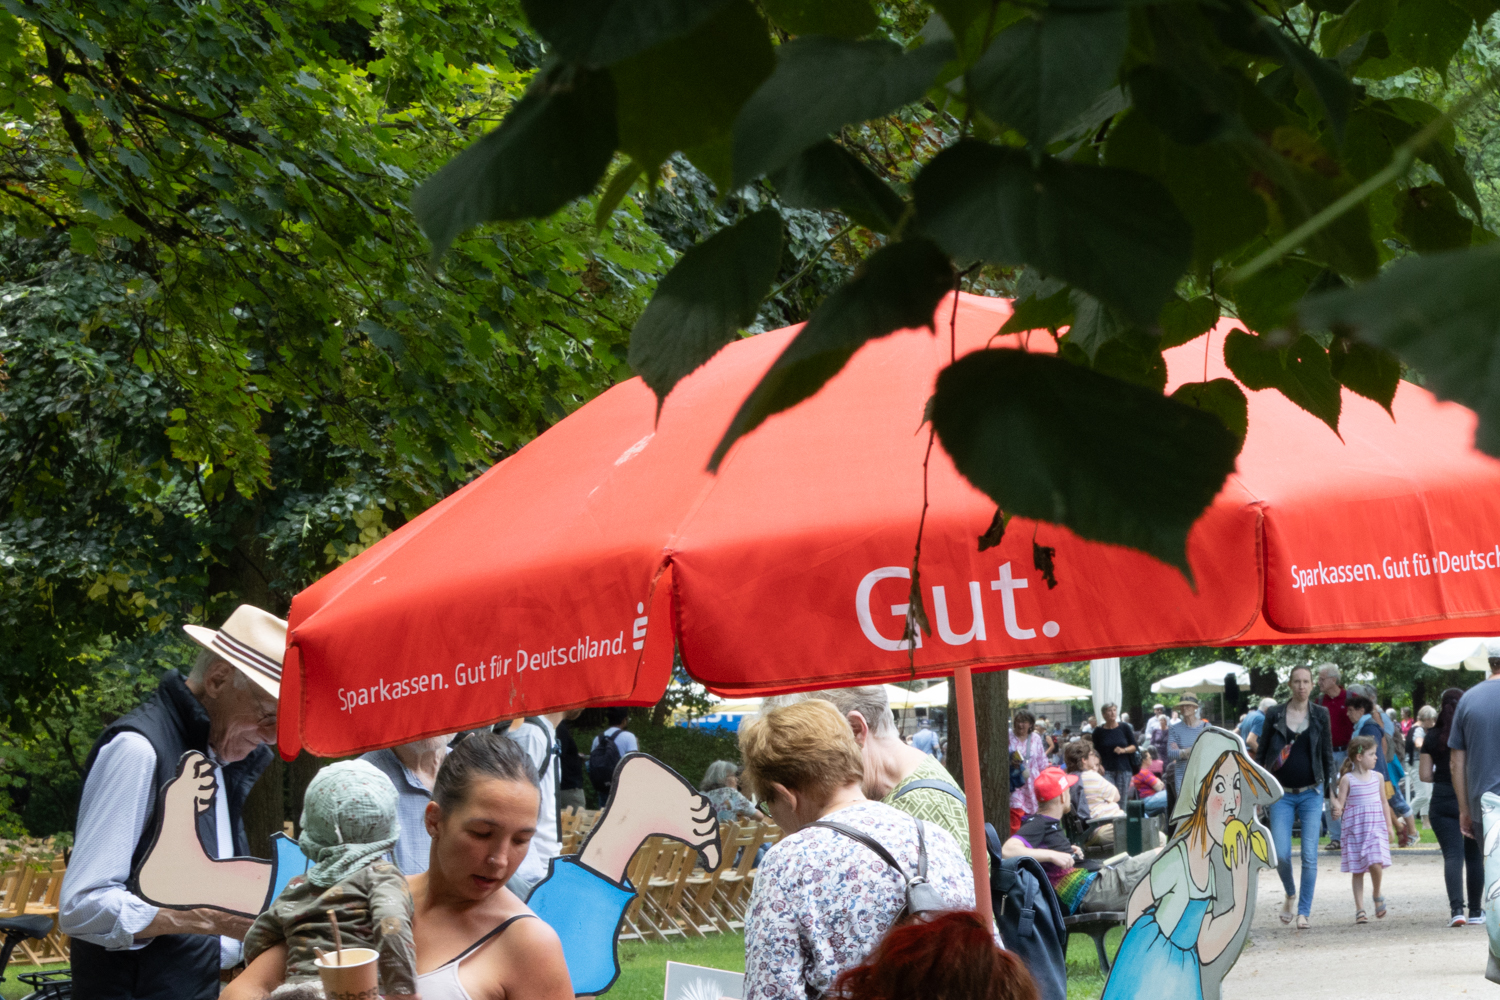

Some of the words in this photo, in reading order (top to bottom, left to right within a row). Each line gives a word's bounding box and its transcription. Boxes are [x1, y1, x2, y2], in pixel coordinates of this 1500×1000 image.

[855, 560, 1061, 652] Gut.
[1290, 560, 1381, 593] Sparkassen.
[1382, 556, 1411, 580] Gut
[1413, 552, 1438, 577] für
[337, 672, 450, 714] Sparkassen.
[455, 662, 487, 686] Gut
[489, 654, 513, 679] für
[516, 631, 628, 674] Deutschland.
